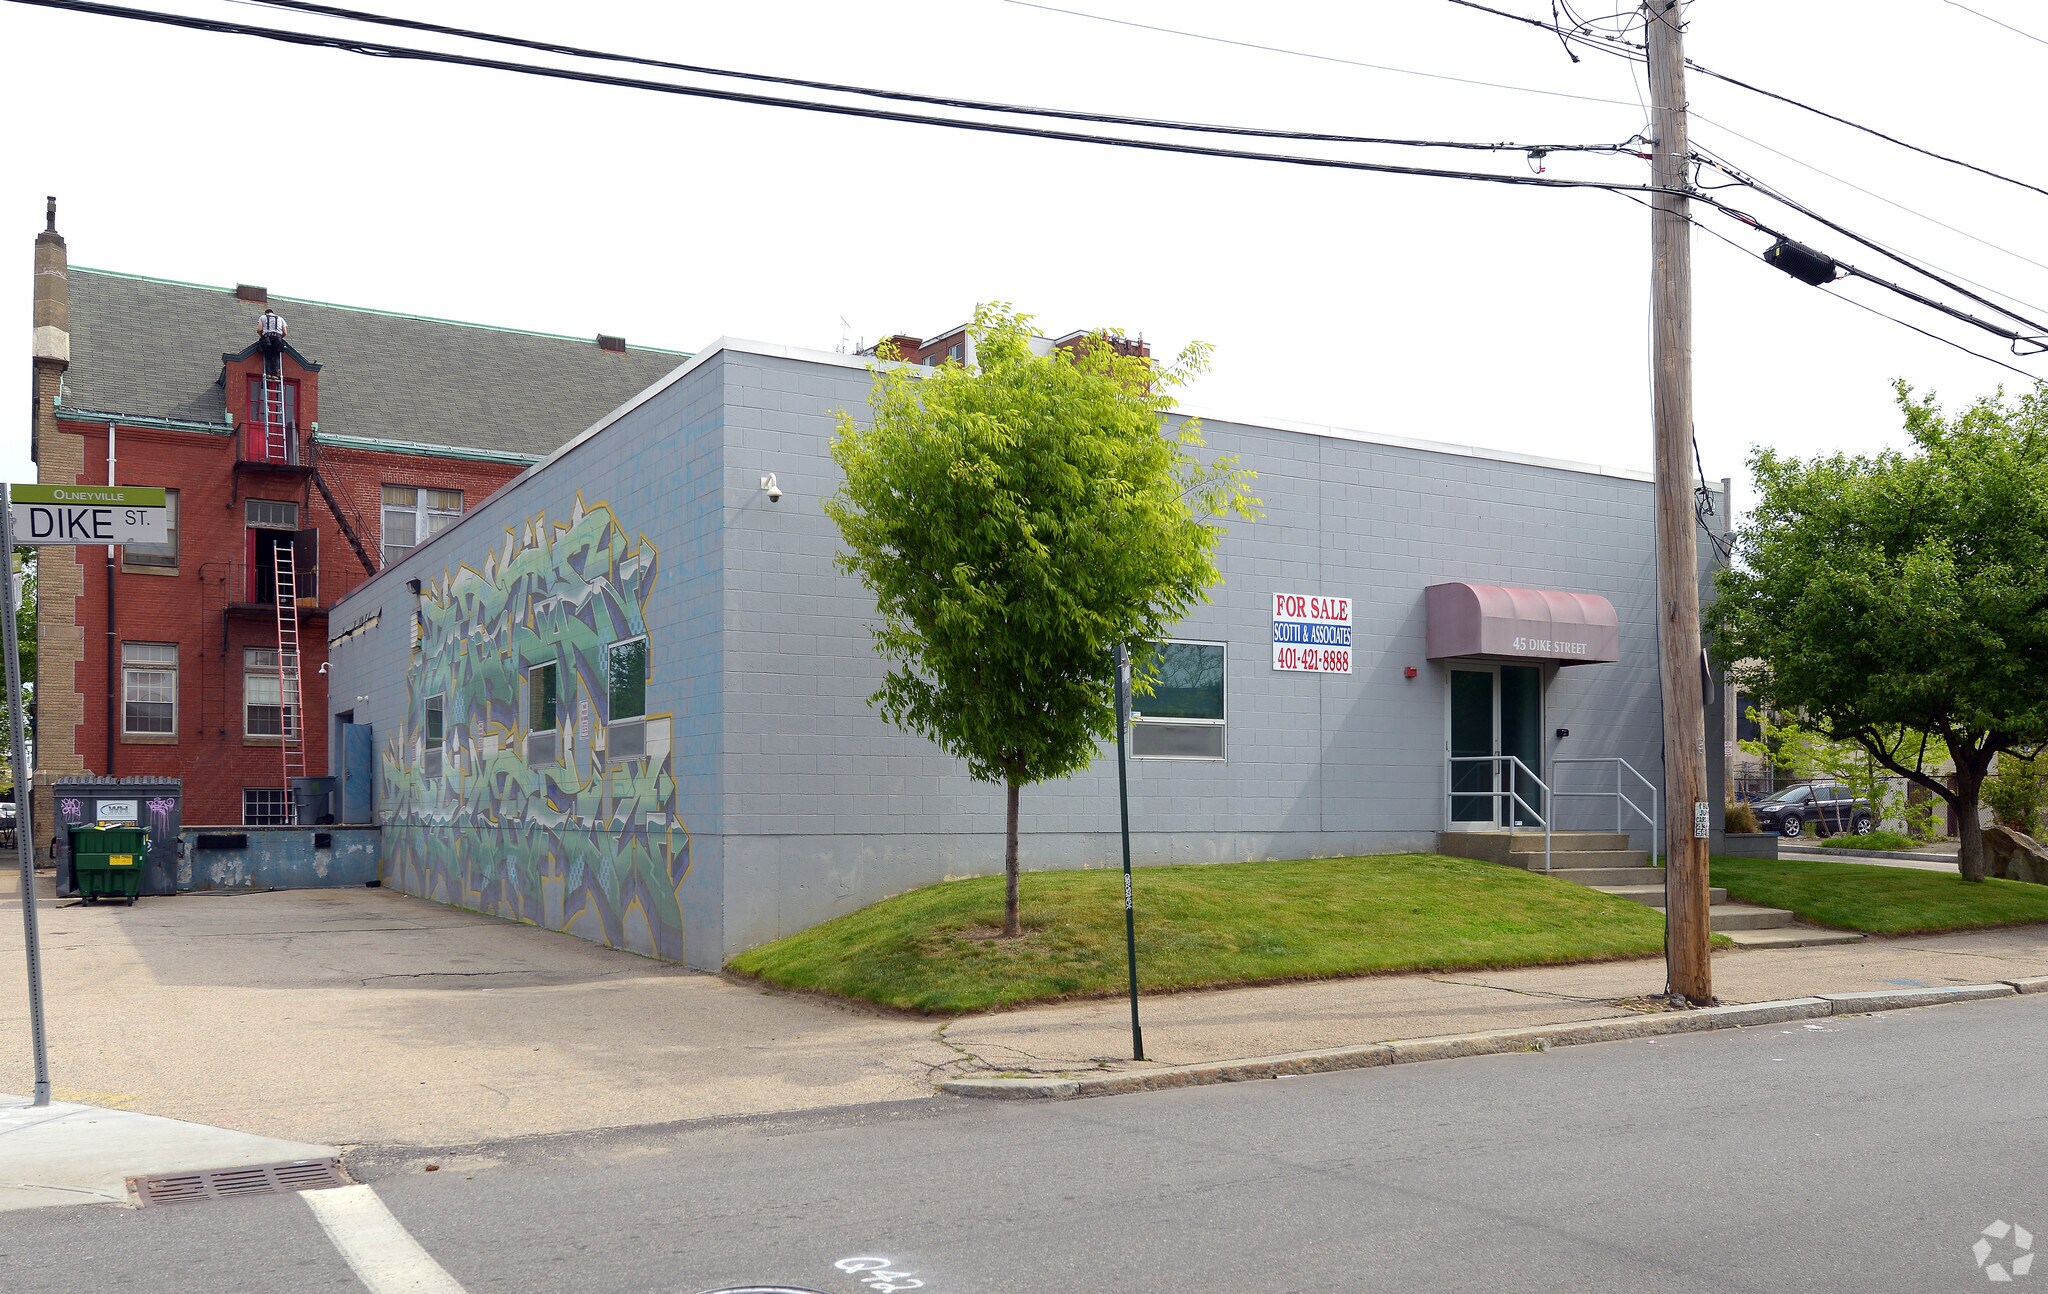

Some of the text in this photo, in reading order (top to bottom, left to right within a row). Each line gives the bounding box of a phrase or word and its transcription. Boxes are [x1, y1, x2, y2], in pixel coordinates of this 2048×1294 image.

[30, 507, 150, 539] DIKE ST.
[1276, 594, 1348, 621] FOR SALE
[1274, 622, 1351, 646] SCOTTI & ASSOCIATES
[1512, 636, 1587, 654] 45 DIKE STREET
[1278, 647, 1349, 672] 401-421-8888
